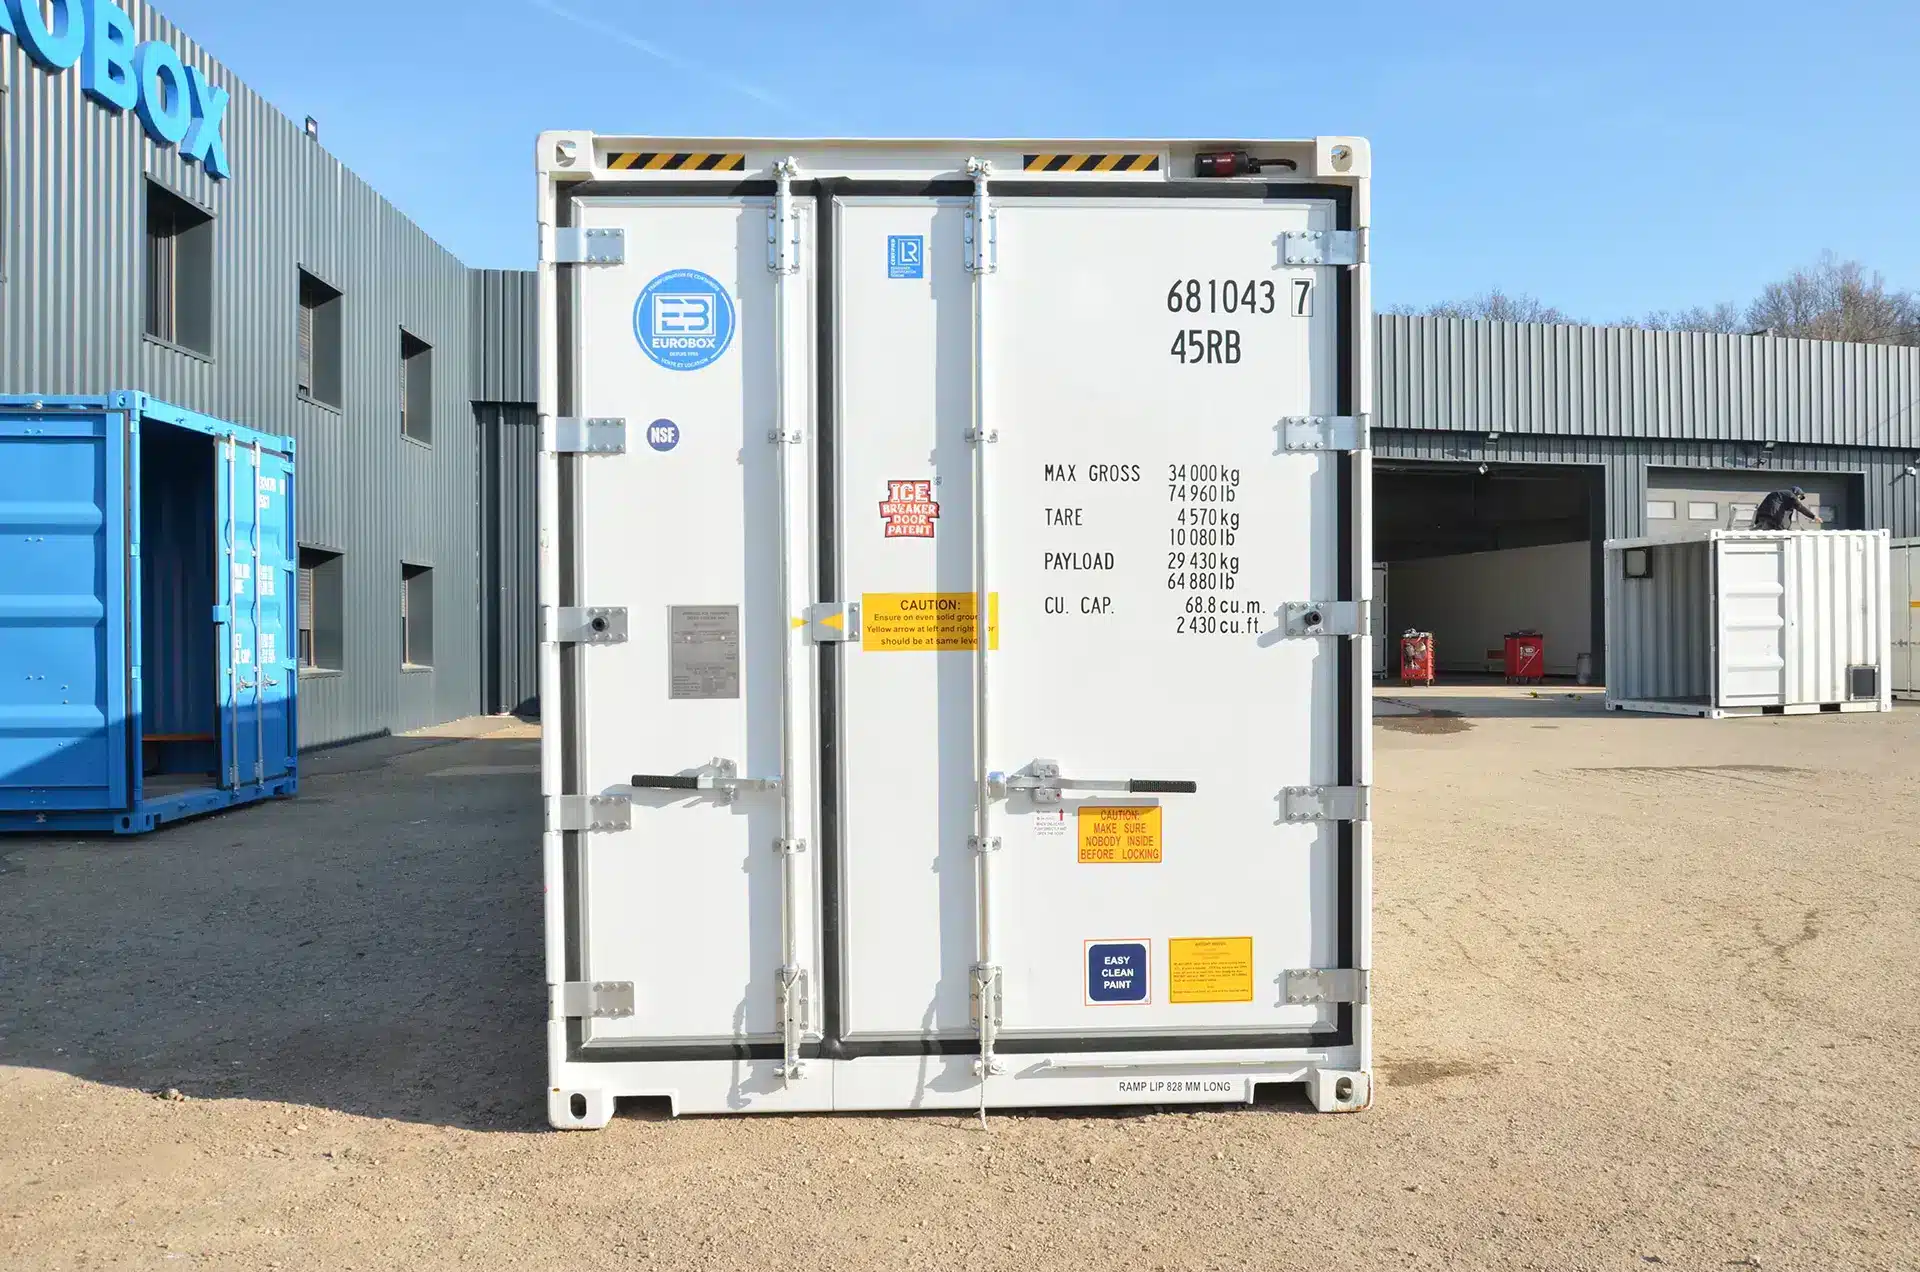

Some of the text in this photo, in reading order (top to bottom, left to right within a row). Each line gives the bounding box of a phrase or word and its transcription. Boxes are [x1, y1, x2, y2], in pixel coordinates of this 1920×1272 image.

[1168, 279, 1310, 314] 681043 7
[652, 338, 716, 349] EUROBOX
[1171, 330, 1240, 363] 45RB
[1045, 464, 1076, 481] MAX
[1089, 465, 1140, 481] GROSS
[1221, 465, 1239, 488] kg
[890, 483, 928, 502] ICE
[1221, 485, 1236, 502] lb
[882, 503, 936, 514] BREAKER
[893, 515, 927, 525] DOOR
[1045, 508, 1082, 525] TARE
[1221, 509, 1239, 531] kg
[887, 525, 931, 535] PATENT
[1221, 529, 1235, 546] lb
[1045, 553, 1114, 570] PAYLOAD
[1221, 553, 1238, 576] kg
[1220, 573, 1235, 590] lb
[900, 599, 961, 611] CAUTION:
[1045, 597, 1068, 614] CU.
[1081, 597, 1114, 614] CAP.
[1186, 596, 1216, 613] 68.8
[874, 613, 901, 622] Ensure
[936, 613, 955, 621] solid
[867, 625, 891, 634] Yellow
[926, 625, 940, 633] left
[941, 625, 955, 633] and
[957, 625, 974, 635] right
[881, 637, 911, 646] should
[912, 637, 923, 646] be
[960, 637, 979, 645] leve
[1100, 808, 1140, 821] CAUTION:
[1093, 822, 1146, 834] MAKE SURE
[1085, 834, 1154, 847] NOBODY INSIDE
[1080, 847, 1159, 860] BEFORE LOCKING
[1105, 956, 1130, 964] EASY
[1102, 969, 1133, 977] CLEAN
[1104, 980, 1131, 989] PAINT
[1120, 1082, 1230, 1091] RAMP LIP 828 MM LONG
